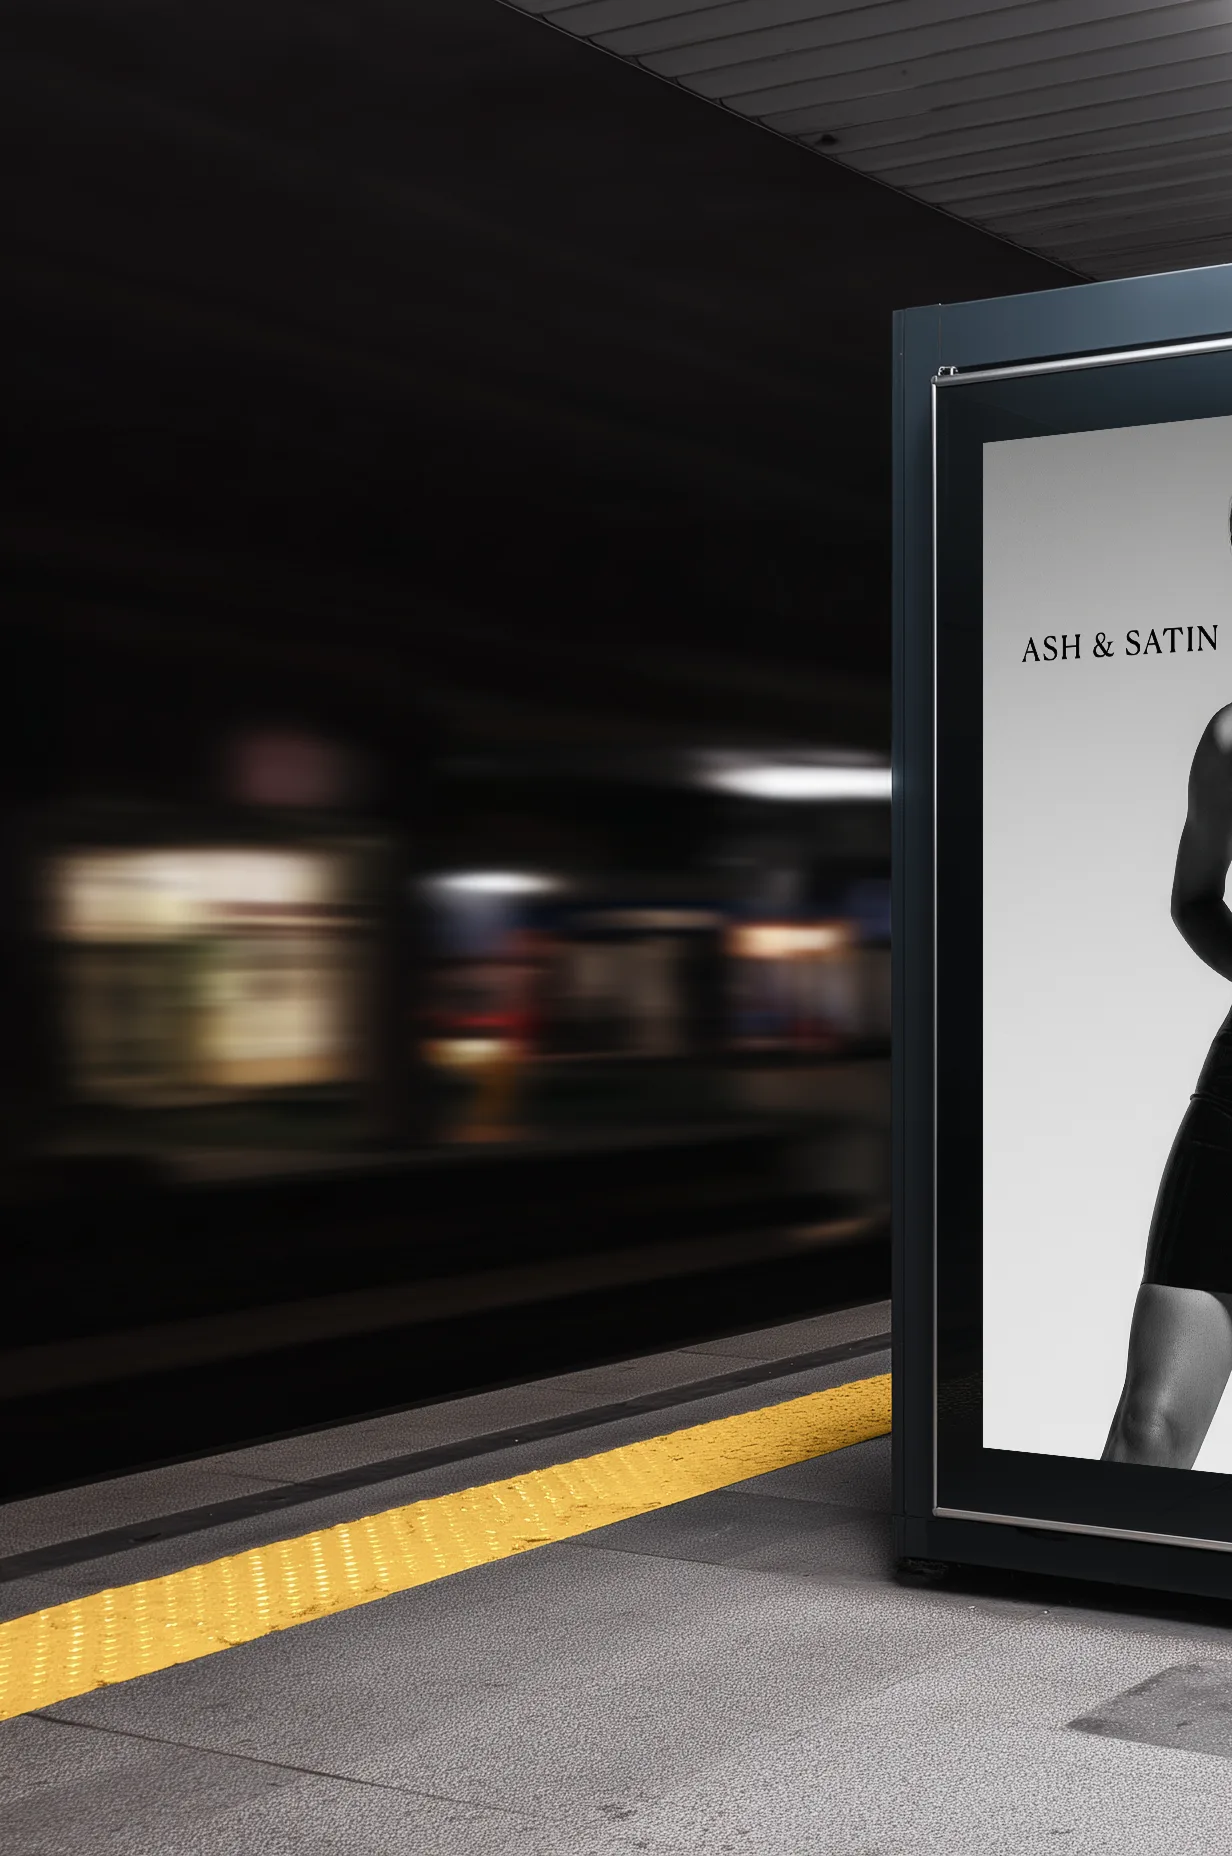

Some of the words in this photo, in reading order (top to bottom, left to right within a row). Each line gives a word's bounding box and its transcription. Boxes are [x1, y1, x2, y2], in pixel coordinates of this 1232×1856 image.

[1021, 633, 1081, 663] ASH
[1092, 631, 1115, 658] &
[1125, 624, 1219, 656] SATIN
